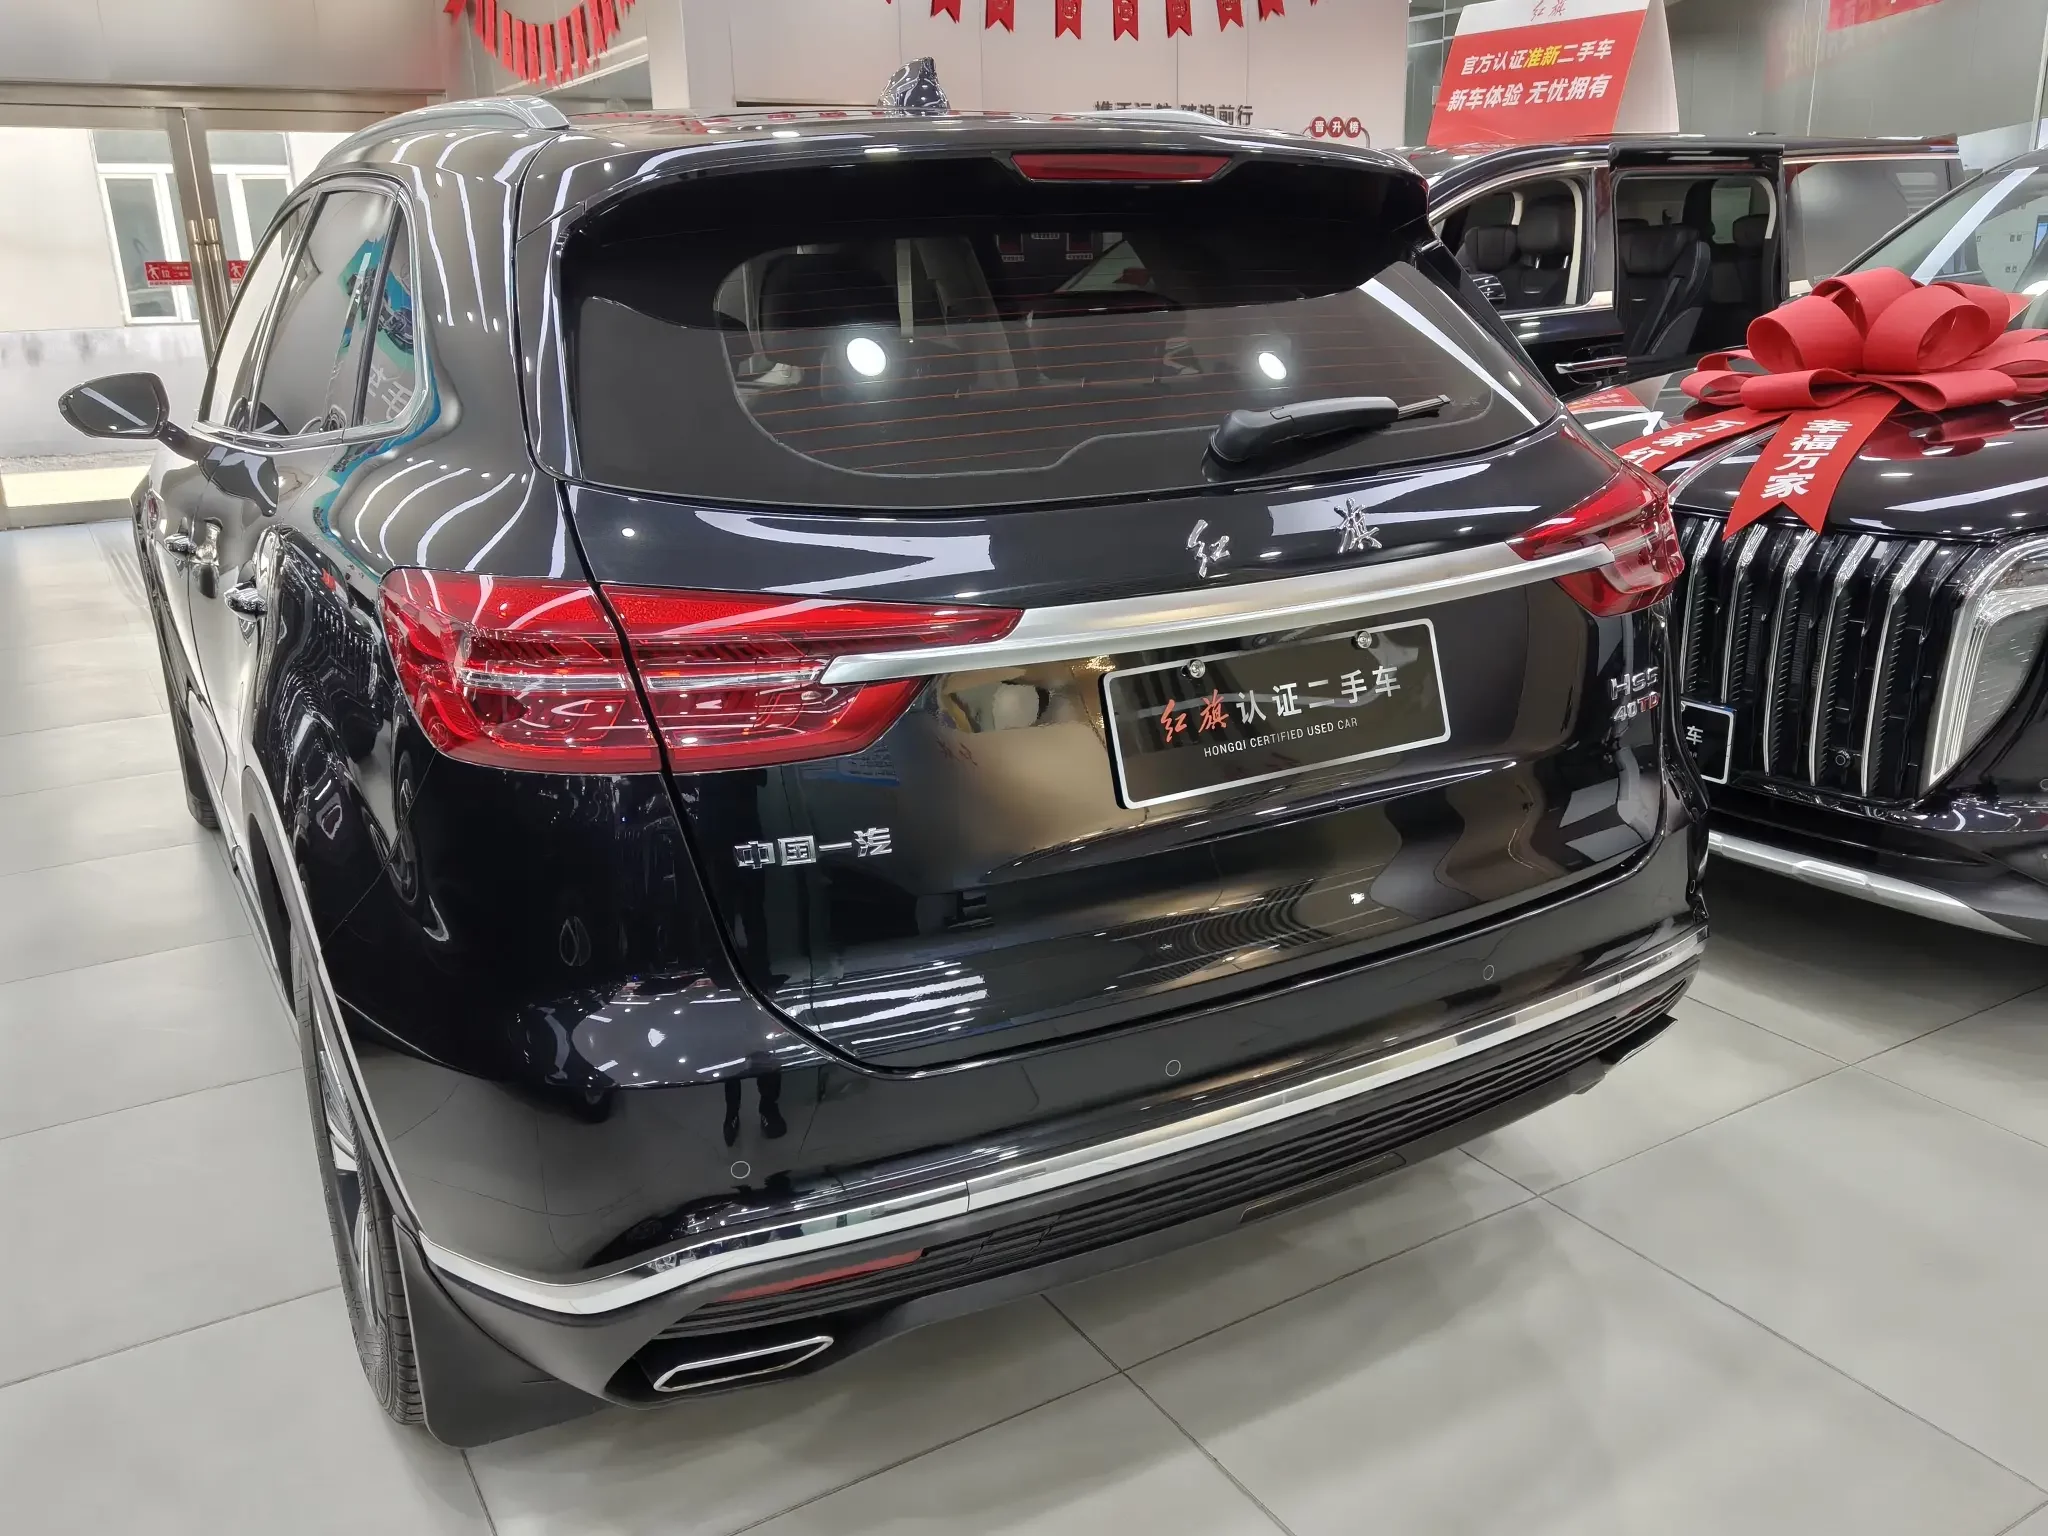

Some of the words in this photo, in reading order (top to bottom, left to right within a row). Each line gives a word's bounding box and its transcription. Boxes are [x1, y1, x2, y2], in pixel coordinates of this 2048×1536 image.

[1461, 38, 1616, 76] 官方认证准新二手车
[1446, 83, 1524, 112] 新车体验
[1525, 73, 1613, 105] 无忧拥有
[1314, 119, 1361, 134] 晋升榜
[1761, 419, 1853, 499] 幸福万家
[1160, 664, 1401, 743] 红旗认证二手车
[1613, 691, 1661, 722] 40TD
[1203, 741, 1247, 758] HONGQI
[1250, 728, 1304, 748] CERTIFIED
[1307, 722, 1335, 737] USED
[1337, 716, 1359, 732] CAR
[1686, 725, 1704, 745] 车
[734, 827, 893, 869] 中国一汽
